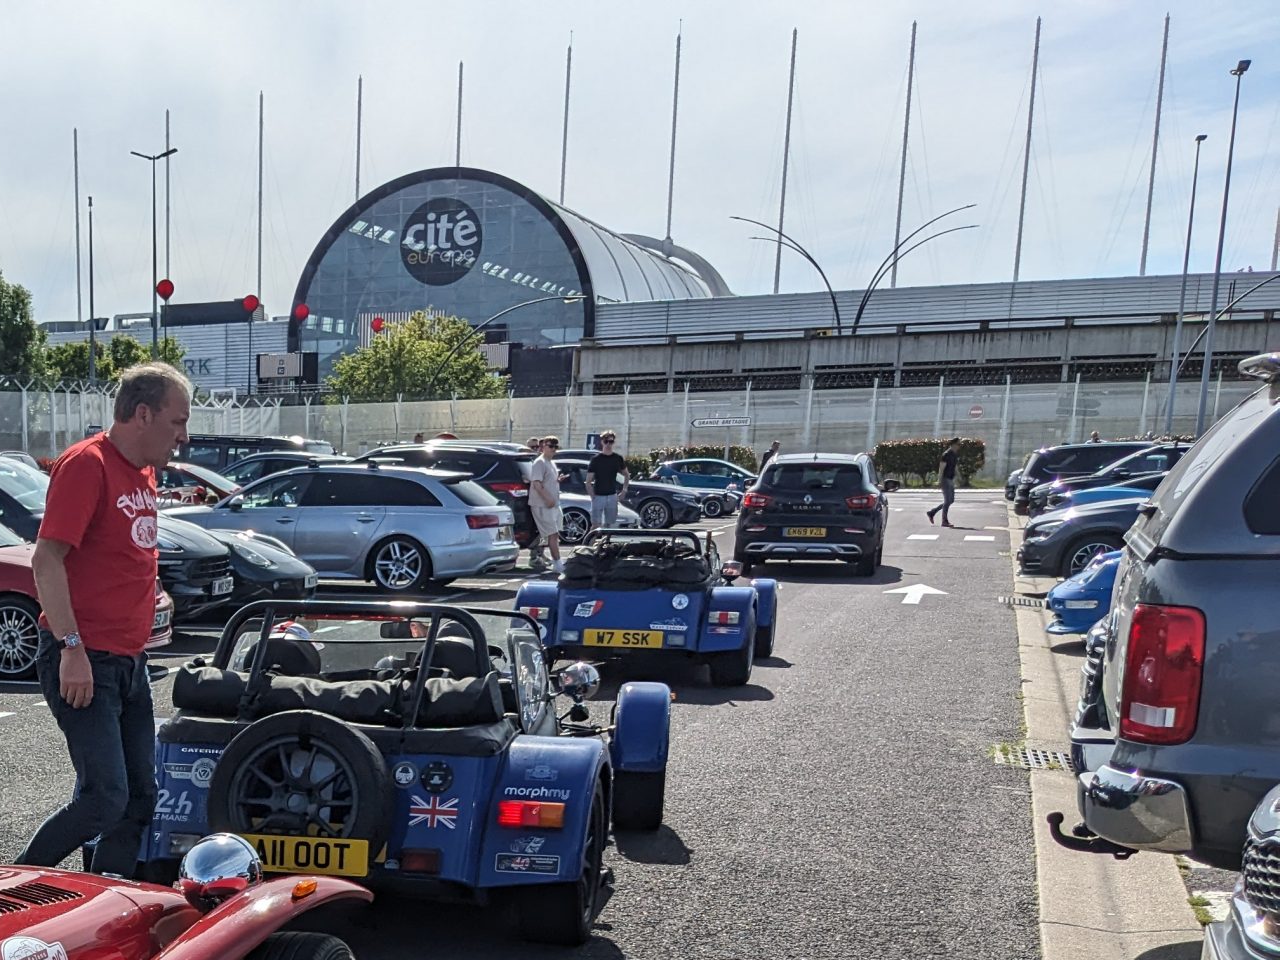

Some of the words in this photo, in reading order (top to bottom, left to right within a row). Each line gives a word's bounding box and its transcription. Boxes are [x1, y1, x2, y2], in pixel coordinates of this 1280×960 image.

[403, 210, 478, 250] cité
[407, 249, 475, 268] europe
[184, 357, 210, 374] RK
[721, 417, 749, 425] BRETAGNE
[596, 631, 615, 645] W7
[621, 632, 651, 646] SSK
[181, 747, 225, 755] CATERHA
[504, 785, 571, 801] morphmy
[161, 814, 189, 822] MANS
